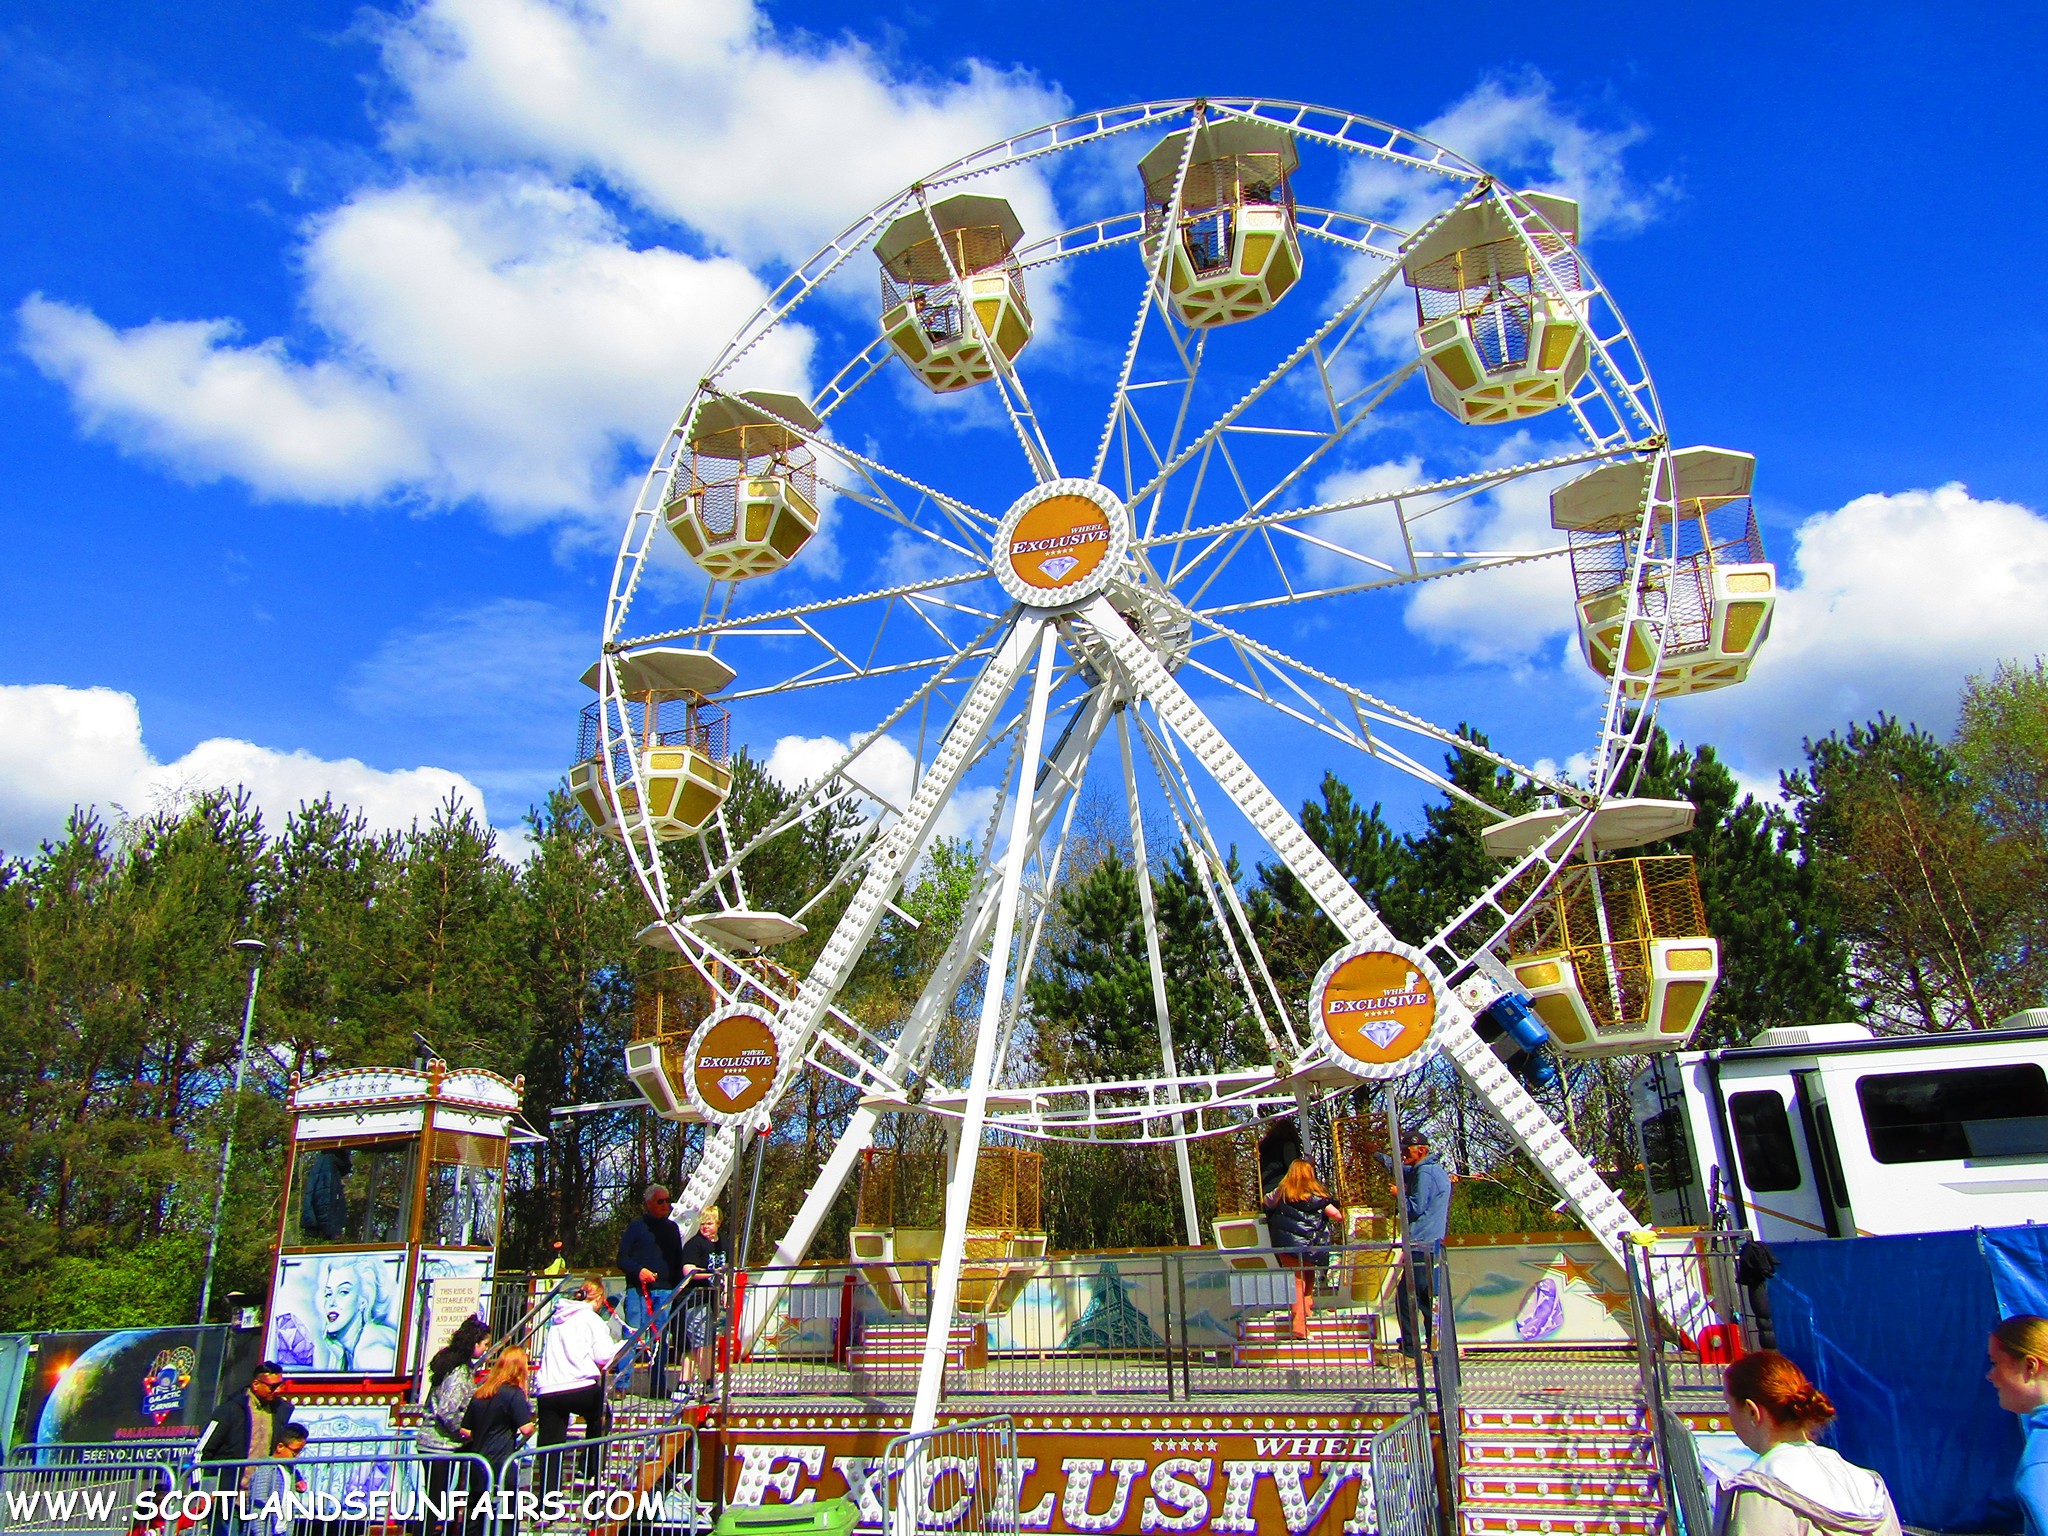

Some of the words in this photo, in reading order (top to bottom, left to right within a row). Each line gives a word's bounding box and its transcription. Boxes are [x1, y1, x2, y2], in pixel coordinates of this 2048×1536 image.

[1071, 523, 1103, 533] WHEEL
[1010, 529, 1110, 555] EXCLUSIVE
[1383, 988, 1416, 996] WHE
[1328, 993, 1427, 1014] EXCLUSIVE
[698, 1056, 773, 1068] EXCLUSIVE
[83, 1449, 107, 1461] SEE
[173, 1447, 197, 1458] TIM
